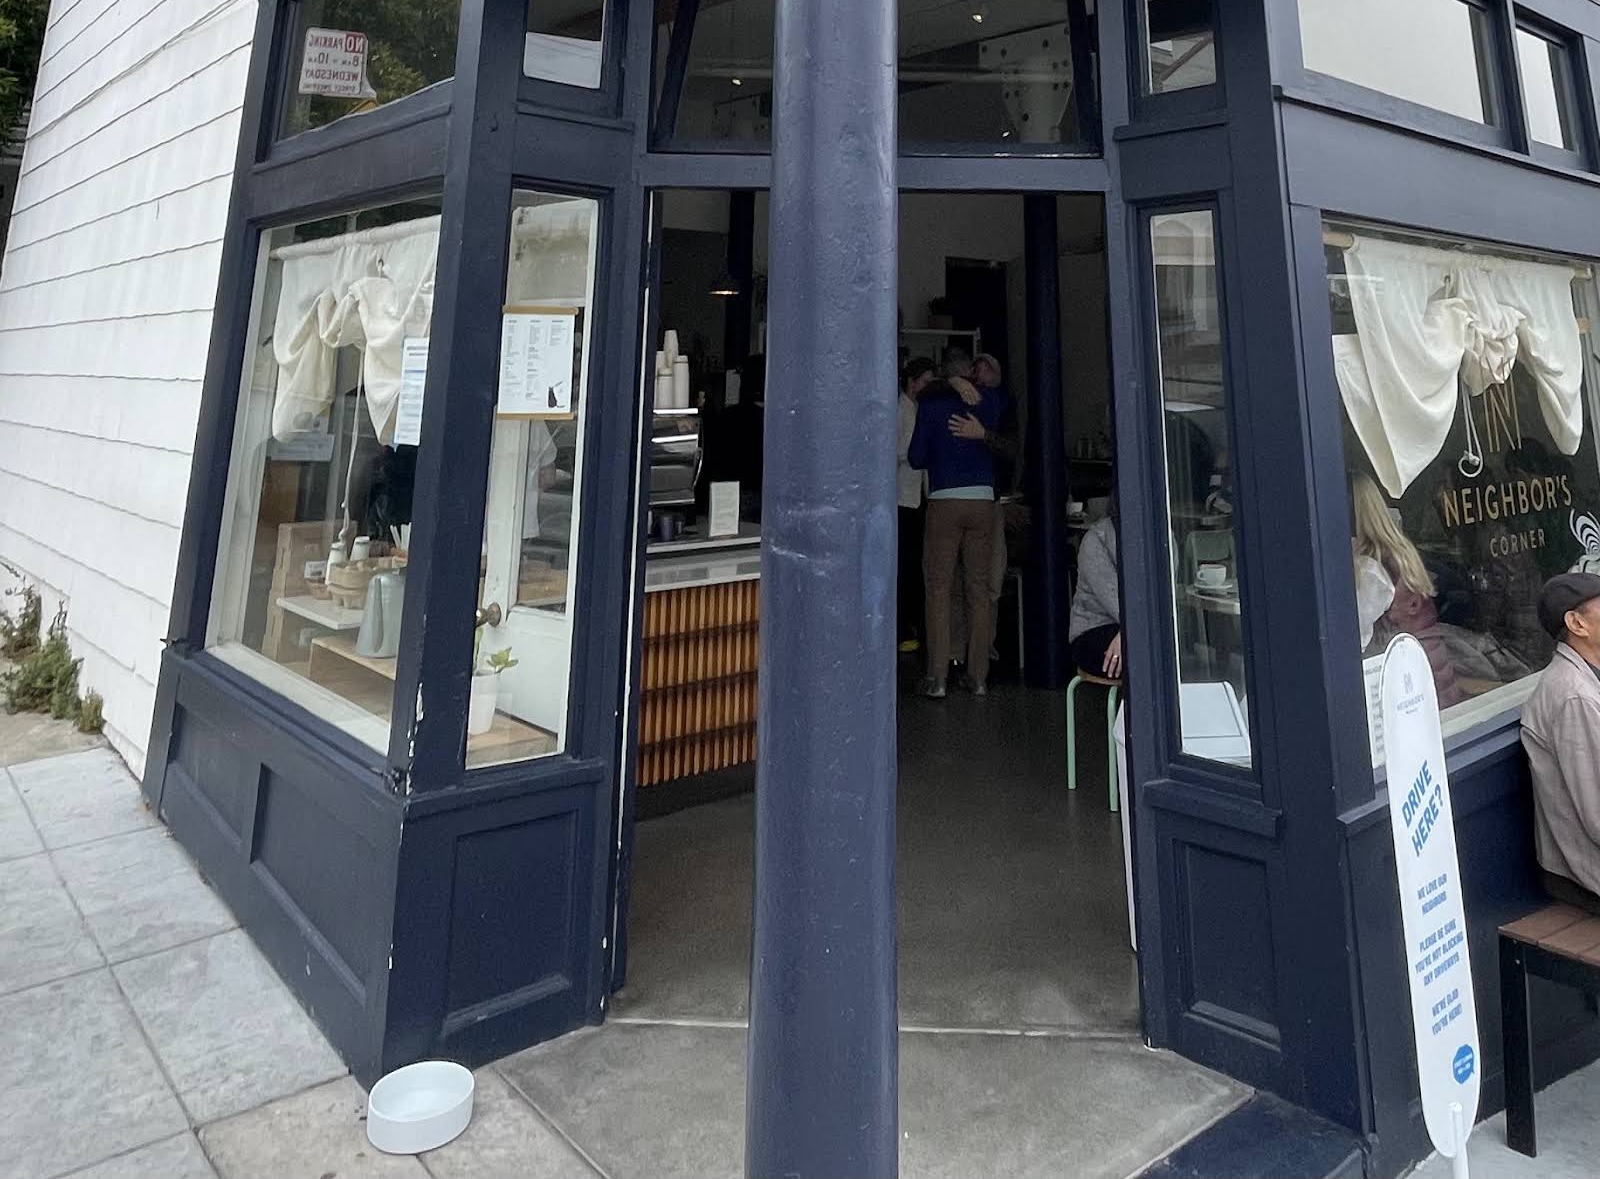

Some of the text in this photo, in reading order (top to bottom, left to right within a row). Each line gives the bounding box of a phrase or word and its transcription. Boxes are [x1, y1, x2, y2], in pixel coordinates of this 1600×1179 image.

[1442, 474, 1572, 528] NEIGHBOR'S
[1490, 528, 1546, 558] CORNER
[1402, 760, 1432, 828] DRIVE
[1412, 784, 1443, 858] HERE?
